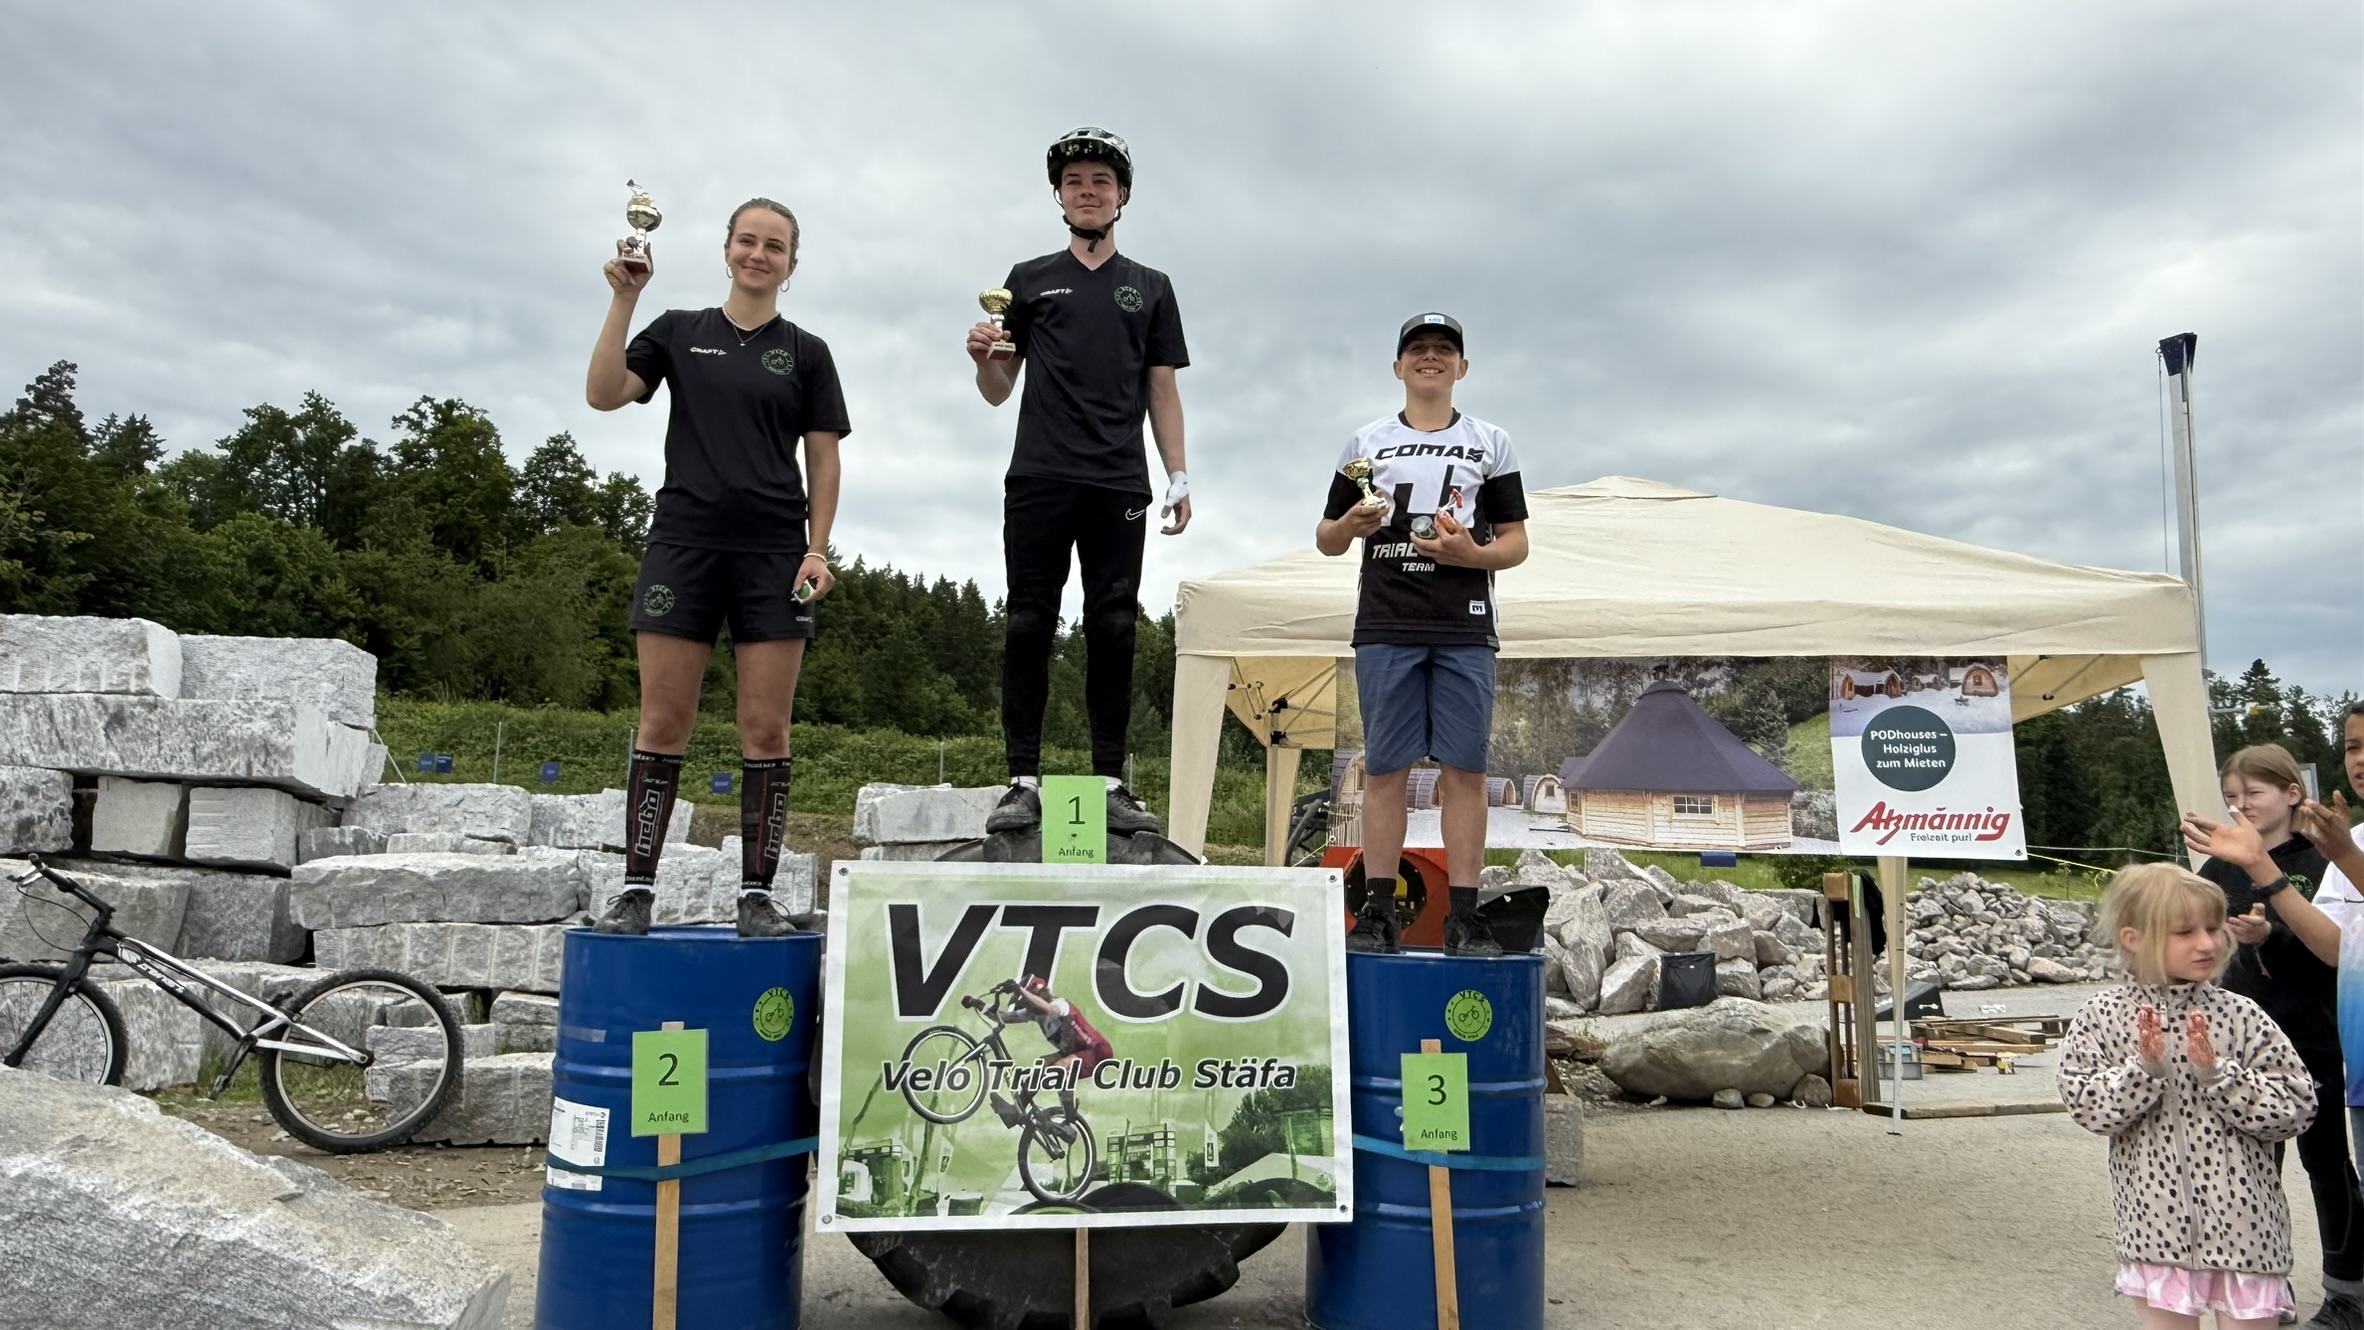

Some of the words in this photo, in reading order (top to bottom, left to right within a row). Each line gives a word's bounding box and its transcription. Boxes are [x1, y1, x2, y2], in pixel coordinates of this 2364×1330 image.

[1375, 443, 1485, 463] COMAS
[1372, 542, 1419, 559] TRIAL
[1870, 730, 1937, 741] PODhouses
[1883, 743, 1937, 756] Holziglus
[1876, 759, 1901, 769] zum
[1904, 757, 1946, 768] Mieten
[1068, 796, 1086, 825] 1
[1910, 832, 1949, 842] Freizeit
[1058, 846, 1094, 859] Anfang
[887, 903, 1296, 1020] VTCS
[658, 1053, 680, 1086] 2
[882, 1060, 971, 1093] Velo
[988, 1059, 1081, 1092] Trial
[1093, 1058, 1182, 1091] Club
[1194, 1056, 1297, 1091] Stäfa
[1428, 1074, 1447, 1106] 3
[648, 1111, 690, 1124] Anfang
[1420, 1128, 1458, 1141] Anfang
